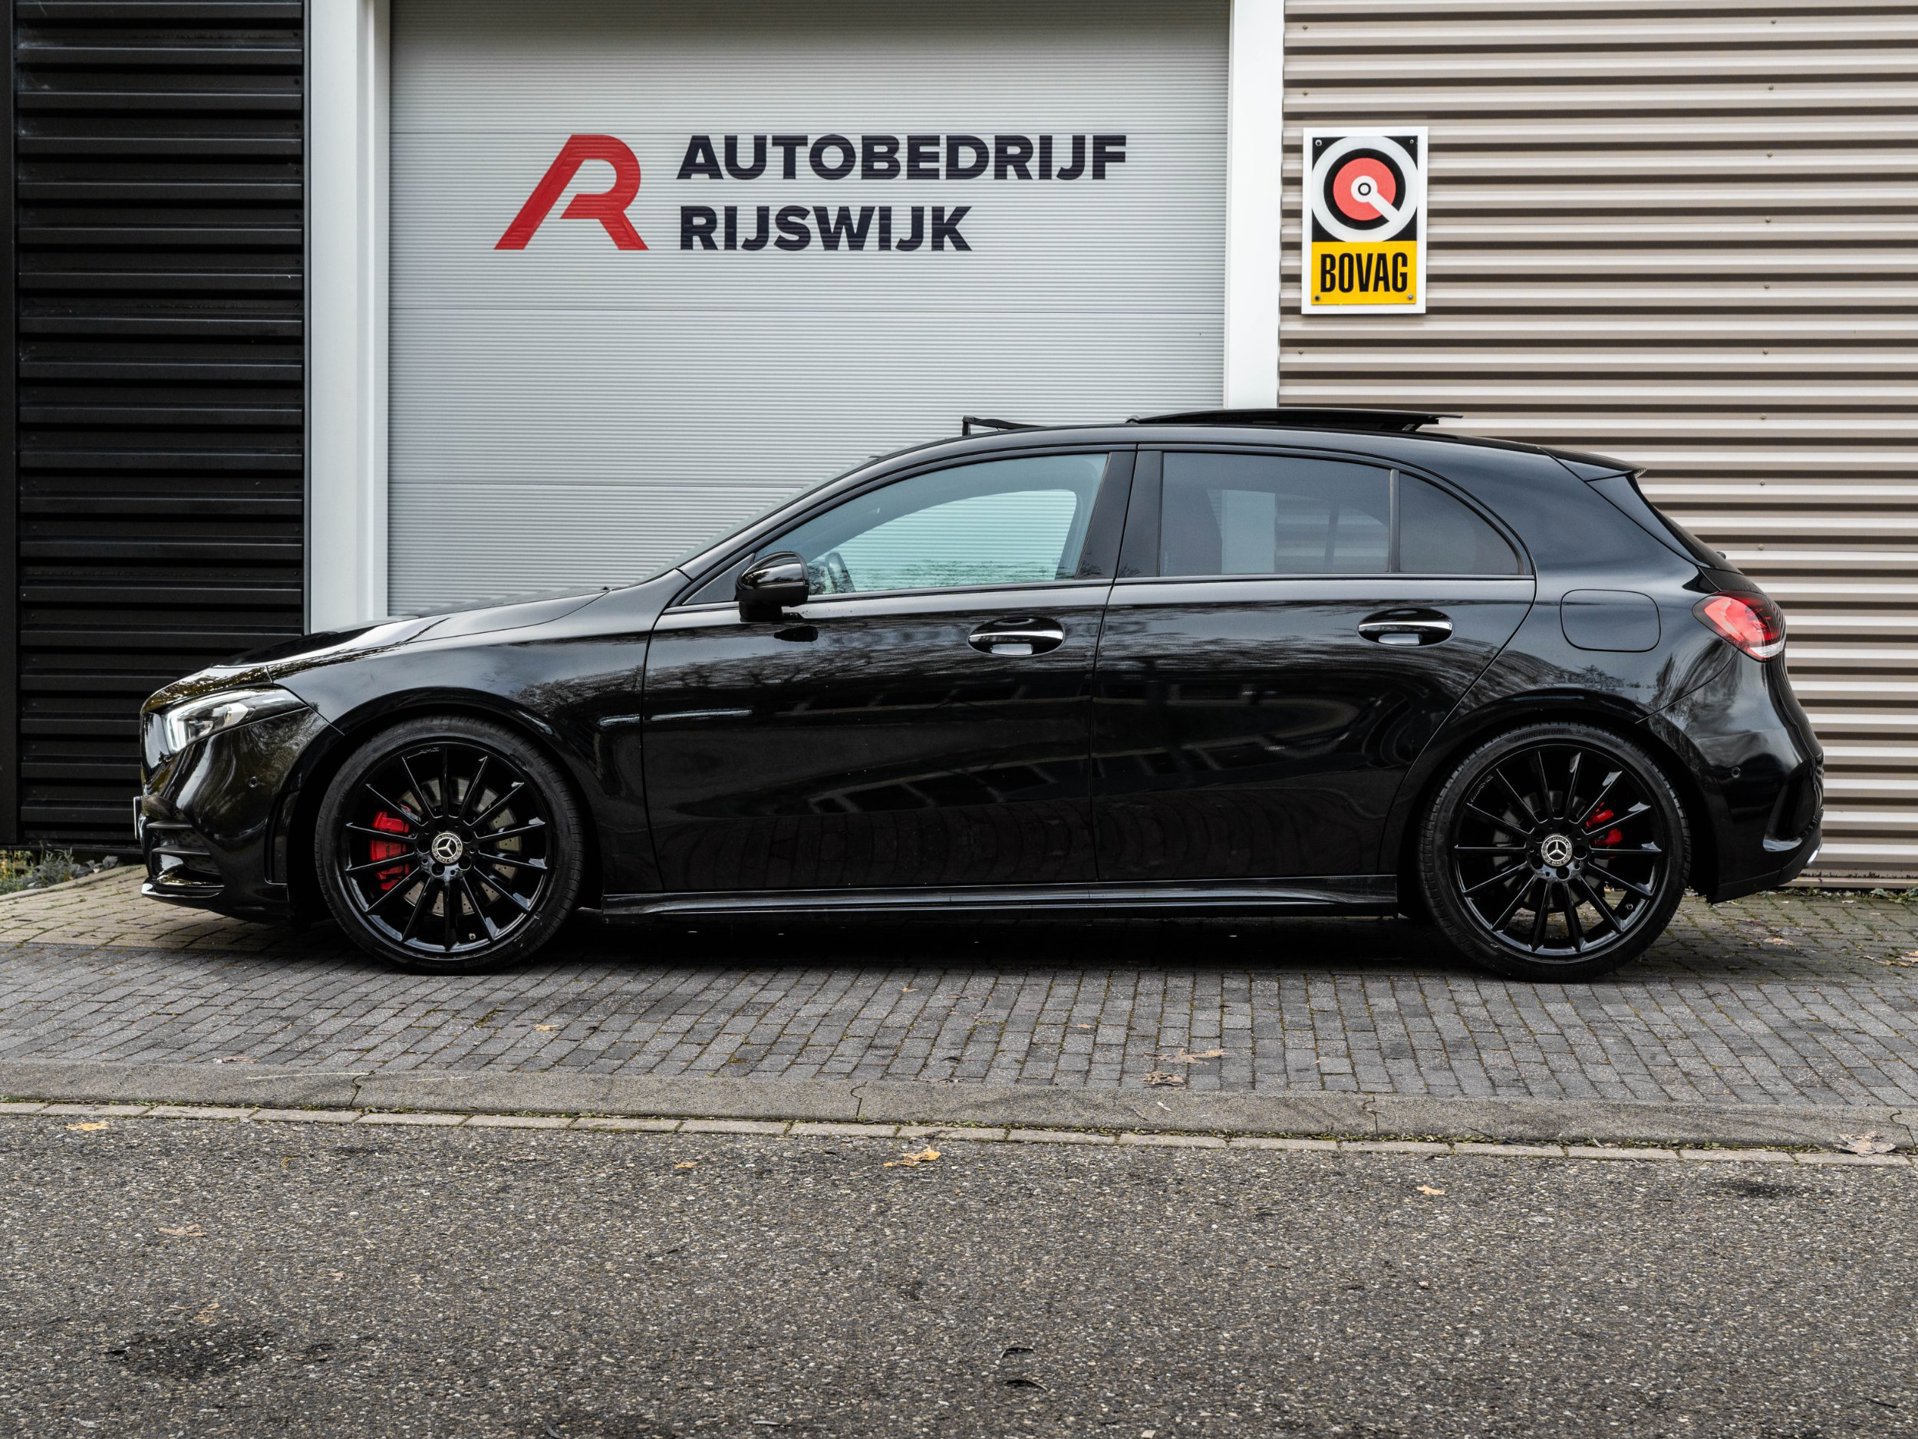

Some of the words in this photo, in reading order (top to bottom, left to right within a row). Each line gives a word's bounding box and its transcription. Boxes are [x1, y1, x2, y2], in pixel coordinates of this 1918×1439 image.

[677, 134, 1127, 181] AUTOBEDRIJF
[680, 205, 972, 251] RIJSWIJK
[1320, 252, 1408, 293] BOVAG
